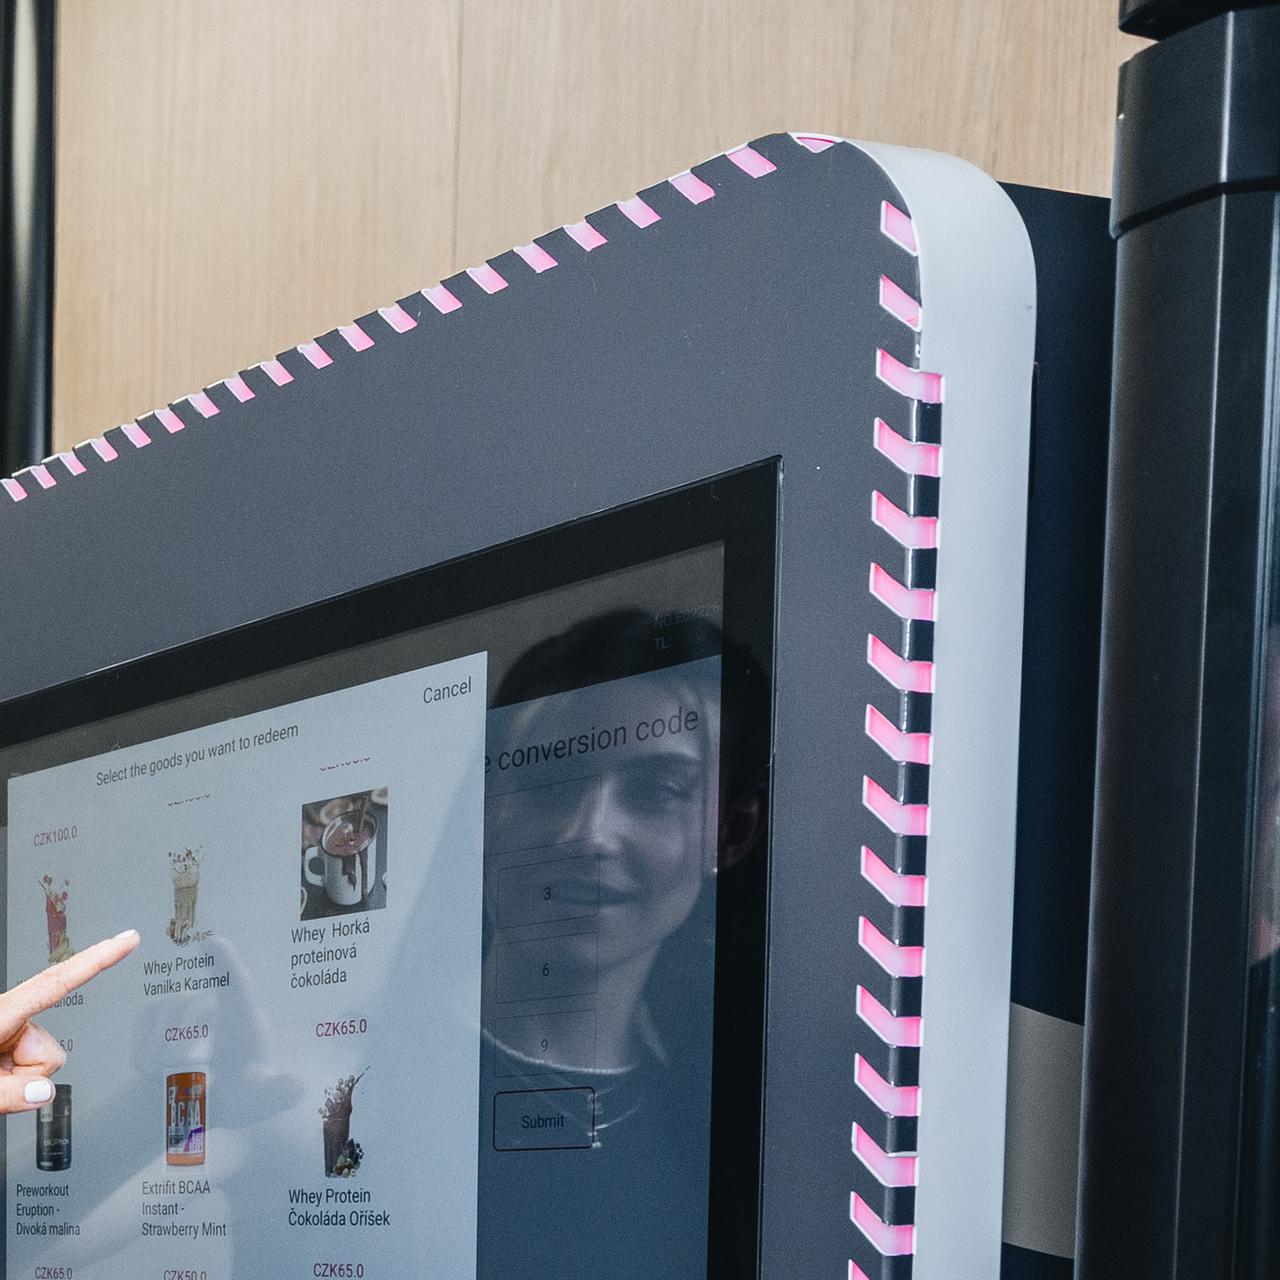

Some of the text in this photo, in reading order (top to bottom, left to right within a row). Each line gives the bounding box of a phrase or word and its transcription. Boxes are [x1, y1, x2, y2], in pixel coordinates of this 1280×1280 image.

[422, 676, 473, 704] Cancel
[498, 726, 627, 771] conversion
[636, 706, 699, 742] code
[96, 724, 299, 786] Select the goods you want to redeem
[34, 825, 78, 846] CZK100.0
[543, 887, 551, 901] 3
[292, 917, 370, 944] Whey Horká
[291, 942, 357, 969] proteinová
[143, 954, 215, 977] Whey Protein
[542, 964, 550, 977] 6
[143, 972, 230, 997] Vanilka Karamel
[291, 969, 347, 988] čokoláda
[165, 1024, 209, 1042] CZK65.0
[316, 1018, 367, 1037] CZK65.0
[541, 1039, 549, 1052] 9
[522, 1114, 565, 1129] Submit
[16, 1183, 69, 1197] Preworkout
[142, 1180, 211, 1195] Extrifit BCAA
[289, 1188, 371, 1207] Whey Protein
[16, 1203, 54, 1218] Eruption
[142, 1202, 178, 1216] Instant
[288, 1207, 390, 1226] Čokoláda Oříšek
[16, 1222, 80, 1236] Divoká malina
[142, 1222, 227, 1240] Strawberry Mint
[34, 1266, 73, 1280] CZK65.0
[313, 1262, 364, 1278] CZK65.0
